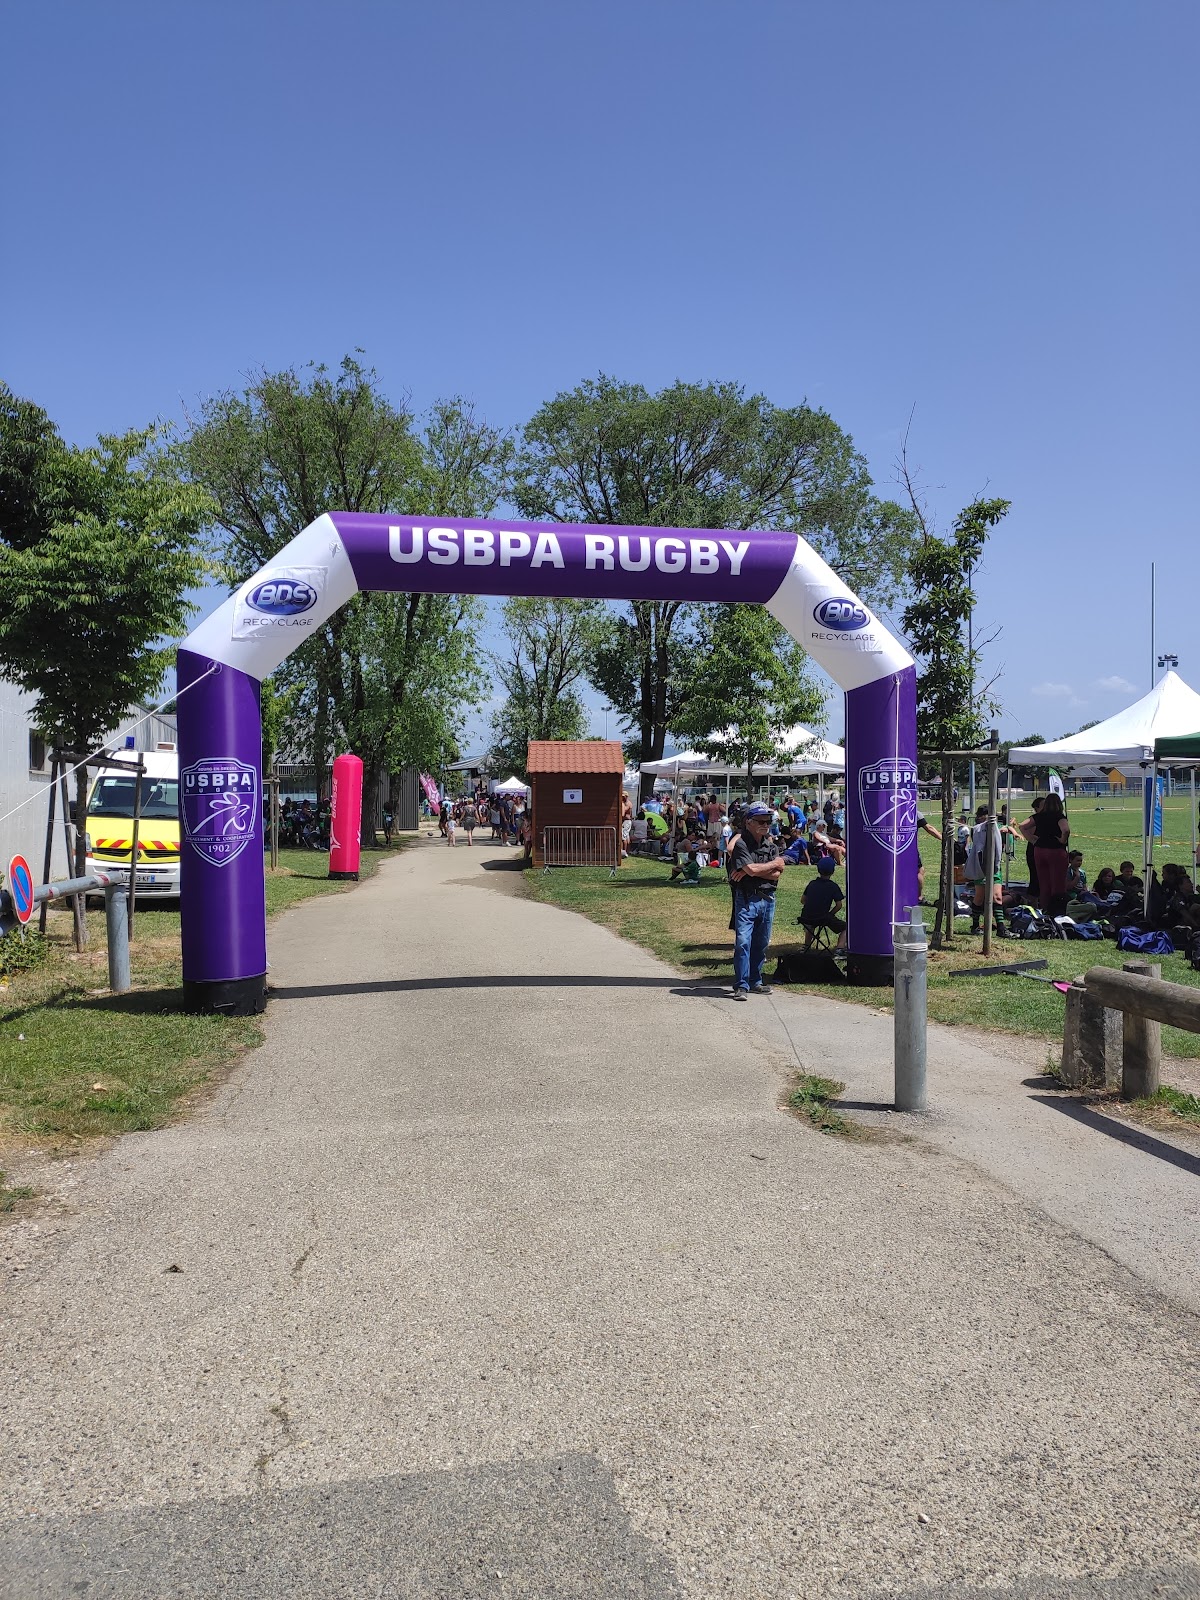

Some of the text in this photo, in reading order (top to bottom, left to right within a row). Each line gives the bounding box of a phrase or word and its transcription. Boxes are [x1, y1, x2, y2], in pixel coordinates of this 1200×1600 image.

[388, 525, 750, 576] USBPA RUGBY
[256, 583, 309, 605] BDS
[824, 601, 867, 623] BDS
[243, 617, 313, 628] RECYCLAGE
[811, 632, 876, 642] RECYCLAGE
[186, 773, 251, 788] USBPA
[866, 771, 917, 784] USBPA
[208, 844, 231, 853] 1902
